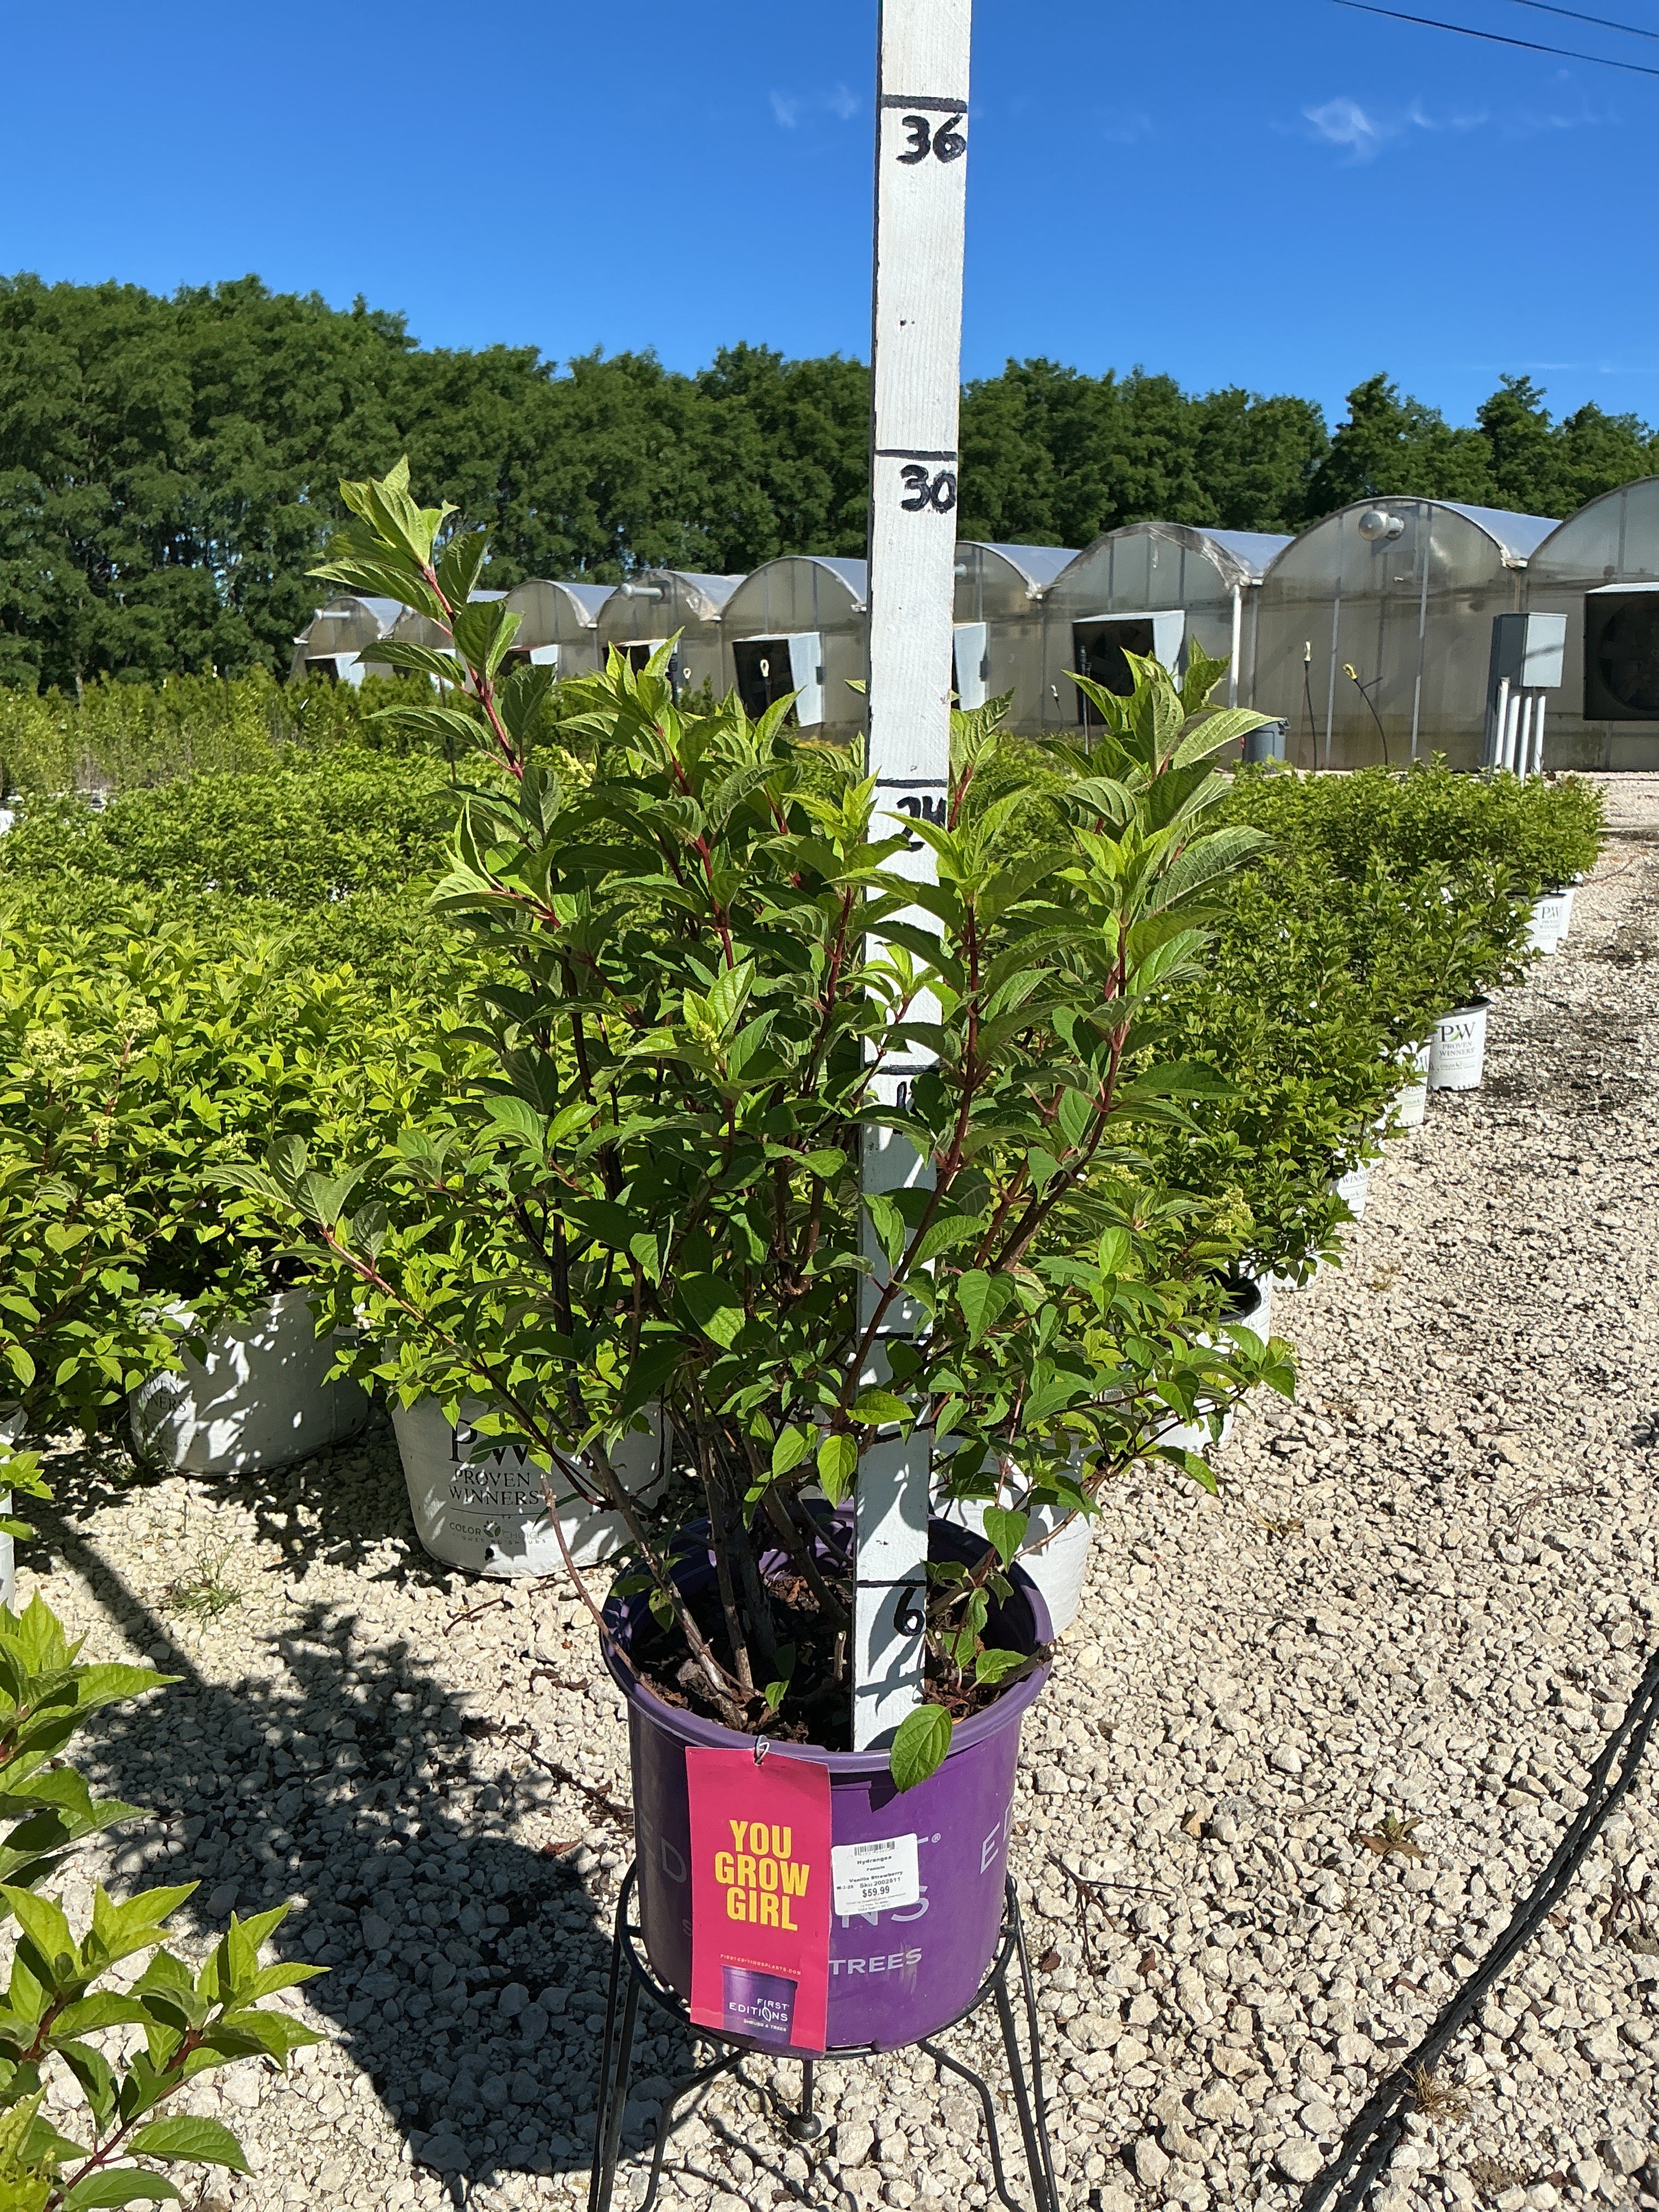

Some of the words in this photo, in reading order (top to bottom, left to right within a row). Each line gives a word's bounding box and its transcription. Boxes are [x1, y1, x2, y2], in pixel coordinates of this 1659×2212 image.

[896, 114, 967, 165] 36
[900, 464, 957, 515] 30
[1441, 1022, 1476, 1042] PW
[1440, 1047, 1475, 1058] WINNERS
[1443, 1042, 1472, 1050] PROVEN
[454, 1468, 531, 1487] PROVEN
[448, 1485, 540, 1506] WINNERS
[449, 1522, 482, 1536] COLOR
[893, 1587, 926, 1637] 6
[729, 1819, 792, 1859] YOU
[857, 1855, 892, 1865] Hydrangea
[715, 1851, 810, 1897] GROW
[871, 1871, 903, 1881] Strawberry
[862, 1885, 890, 1898] $59.99
[726, 1887, 798, 1931] GIRL
[829, 1948, 922, 1975] TREES
[729, 2002, 788, 2022] EDITIONS
[757, 1998, 788, 2011] FIRST
